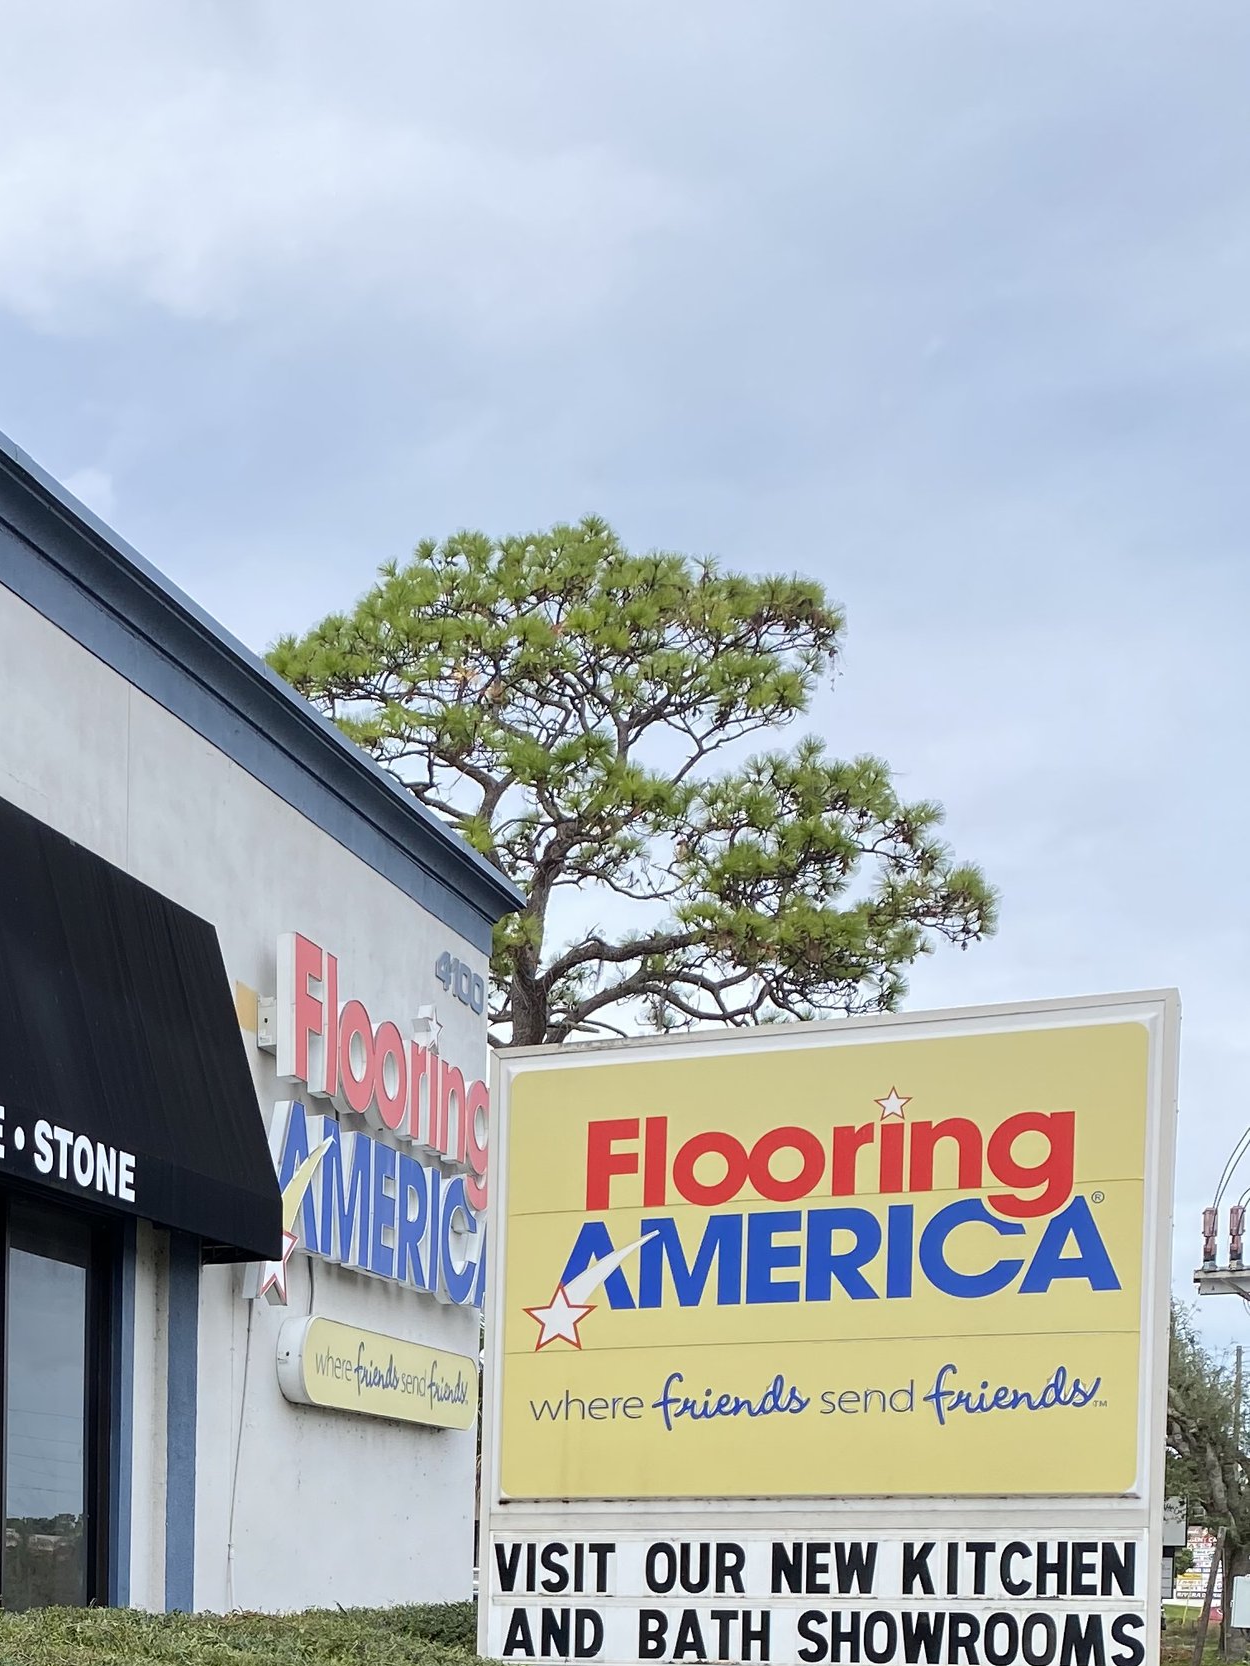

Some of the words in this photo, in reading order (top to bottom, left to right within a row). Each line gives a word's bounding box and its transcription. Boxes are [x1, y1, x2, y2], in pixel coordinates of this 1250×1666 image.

[435, 951, 484, 1015] 4100
[286, 931, 489, 1211] Flooring
[33, 1119, 136, 1202] STONE
[586, 1094, 1075, 1218] Flooring
[278, 1100, 487, 1309] AMERIC
[315, 1346, 352, 1382] where
[353, 1341, 400, 1396] friends
[401, 1369, 427, 1397] send
[530, 1389, 644, 1422] where
[652, 1372, 811, 1432] friends
[820, 1379, 915, 1416] send
[494, 1542, 616, 1594] VISIT
[645, 1541, 746, 1595] OUR
[771, 1541, 878, 1596] NEW
[902, 1541, 1137, 1598] KITCHEN
[502, 1607, 605, 1659] AND
[639, 1609, 771, 1663] BATH
